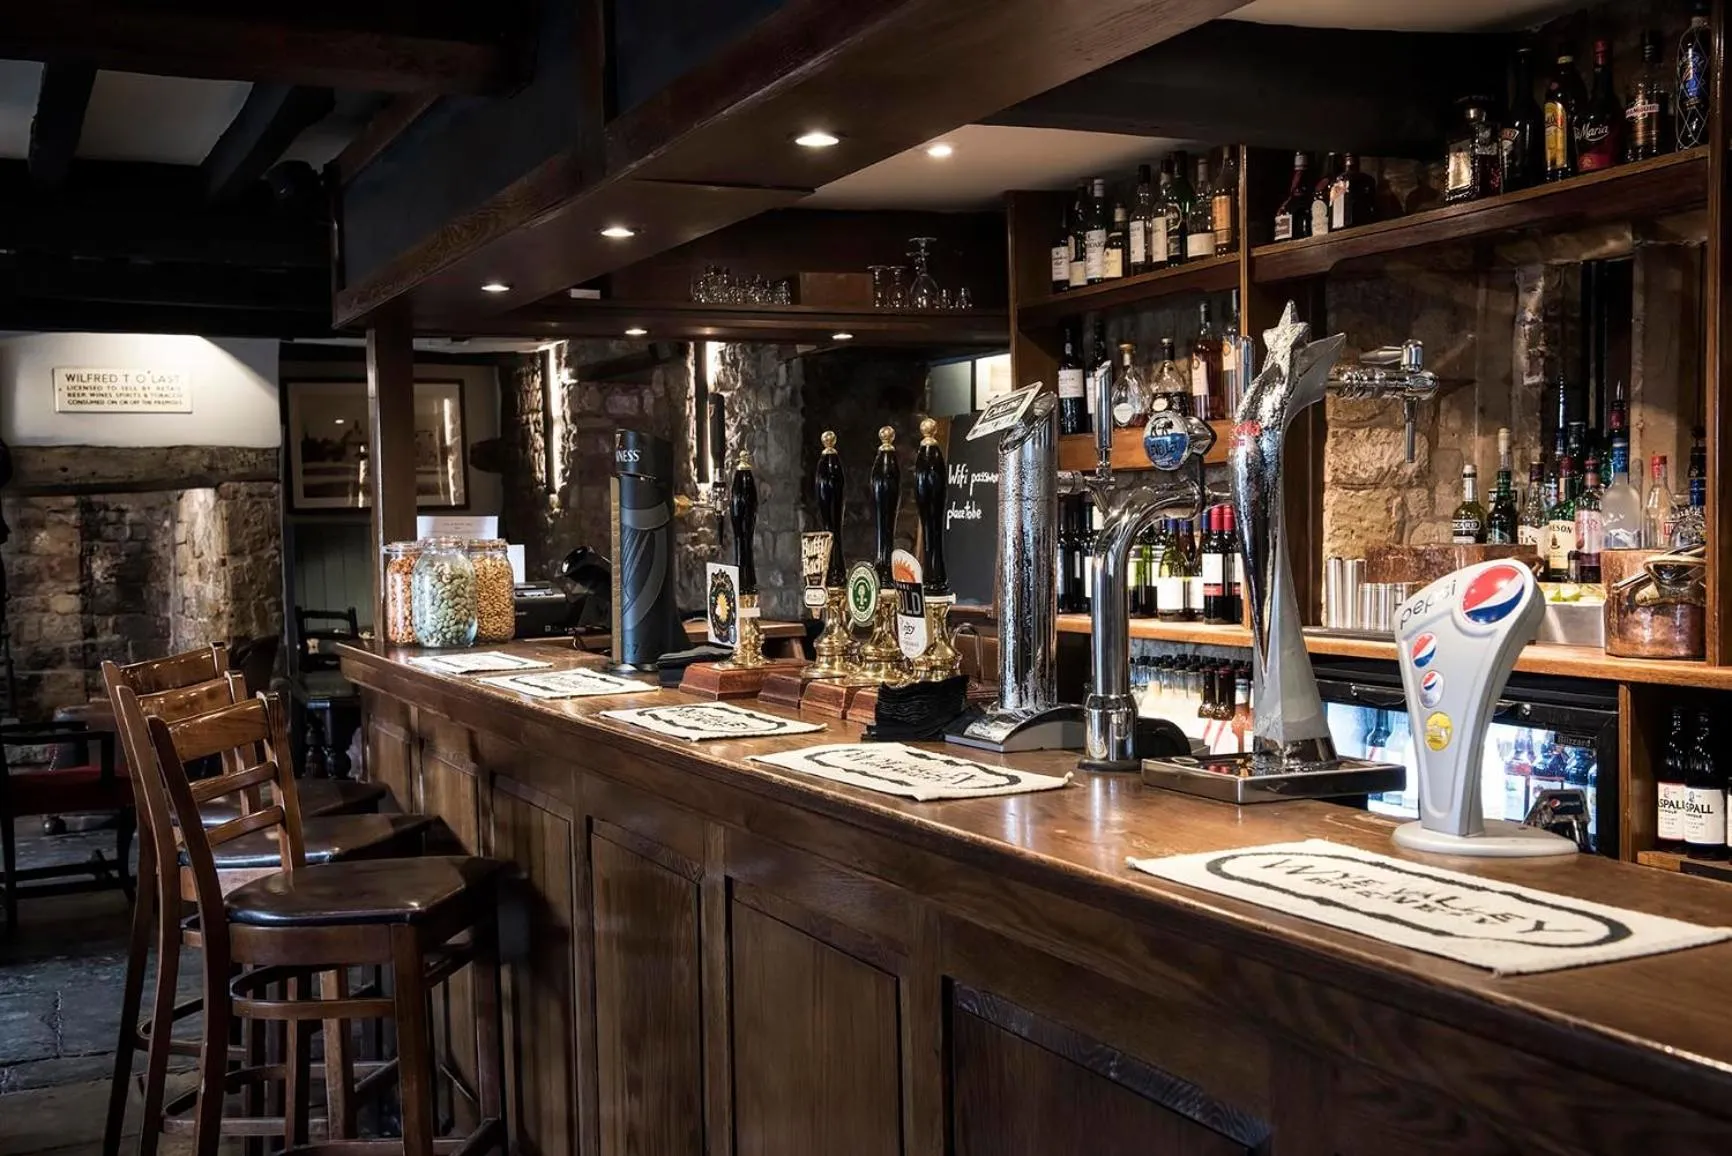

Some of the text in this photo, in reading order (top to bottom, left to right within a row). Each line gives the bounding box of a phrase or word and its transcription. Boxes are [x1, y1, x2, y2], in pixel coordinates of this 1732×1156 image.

[1581, 122, 1609, 139] Maria
[65, 373, 118, 383] WILFRED
[123, 373, 129, 383] T
[615, 449, 641, 462] NESS
[948, 464, 999, 496] Wifi passwor
[1657, 798, 1686, 810] SPALL
[1685, 802, 1714, 814] SPALL
